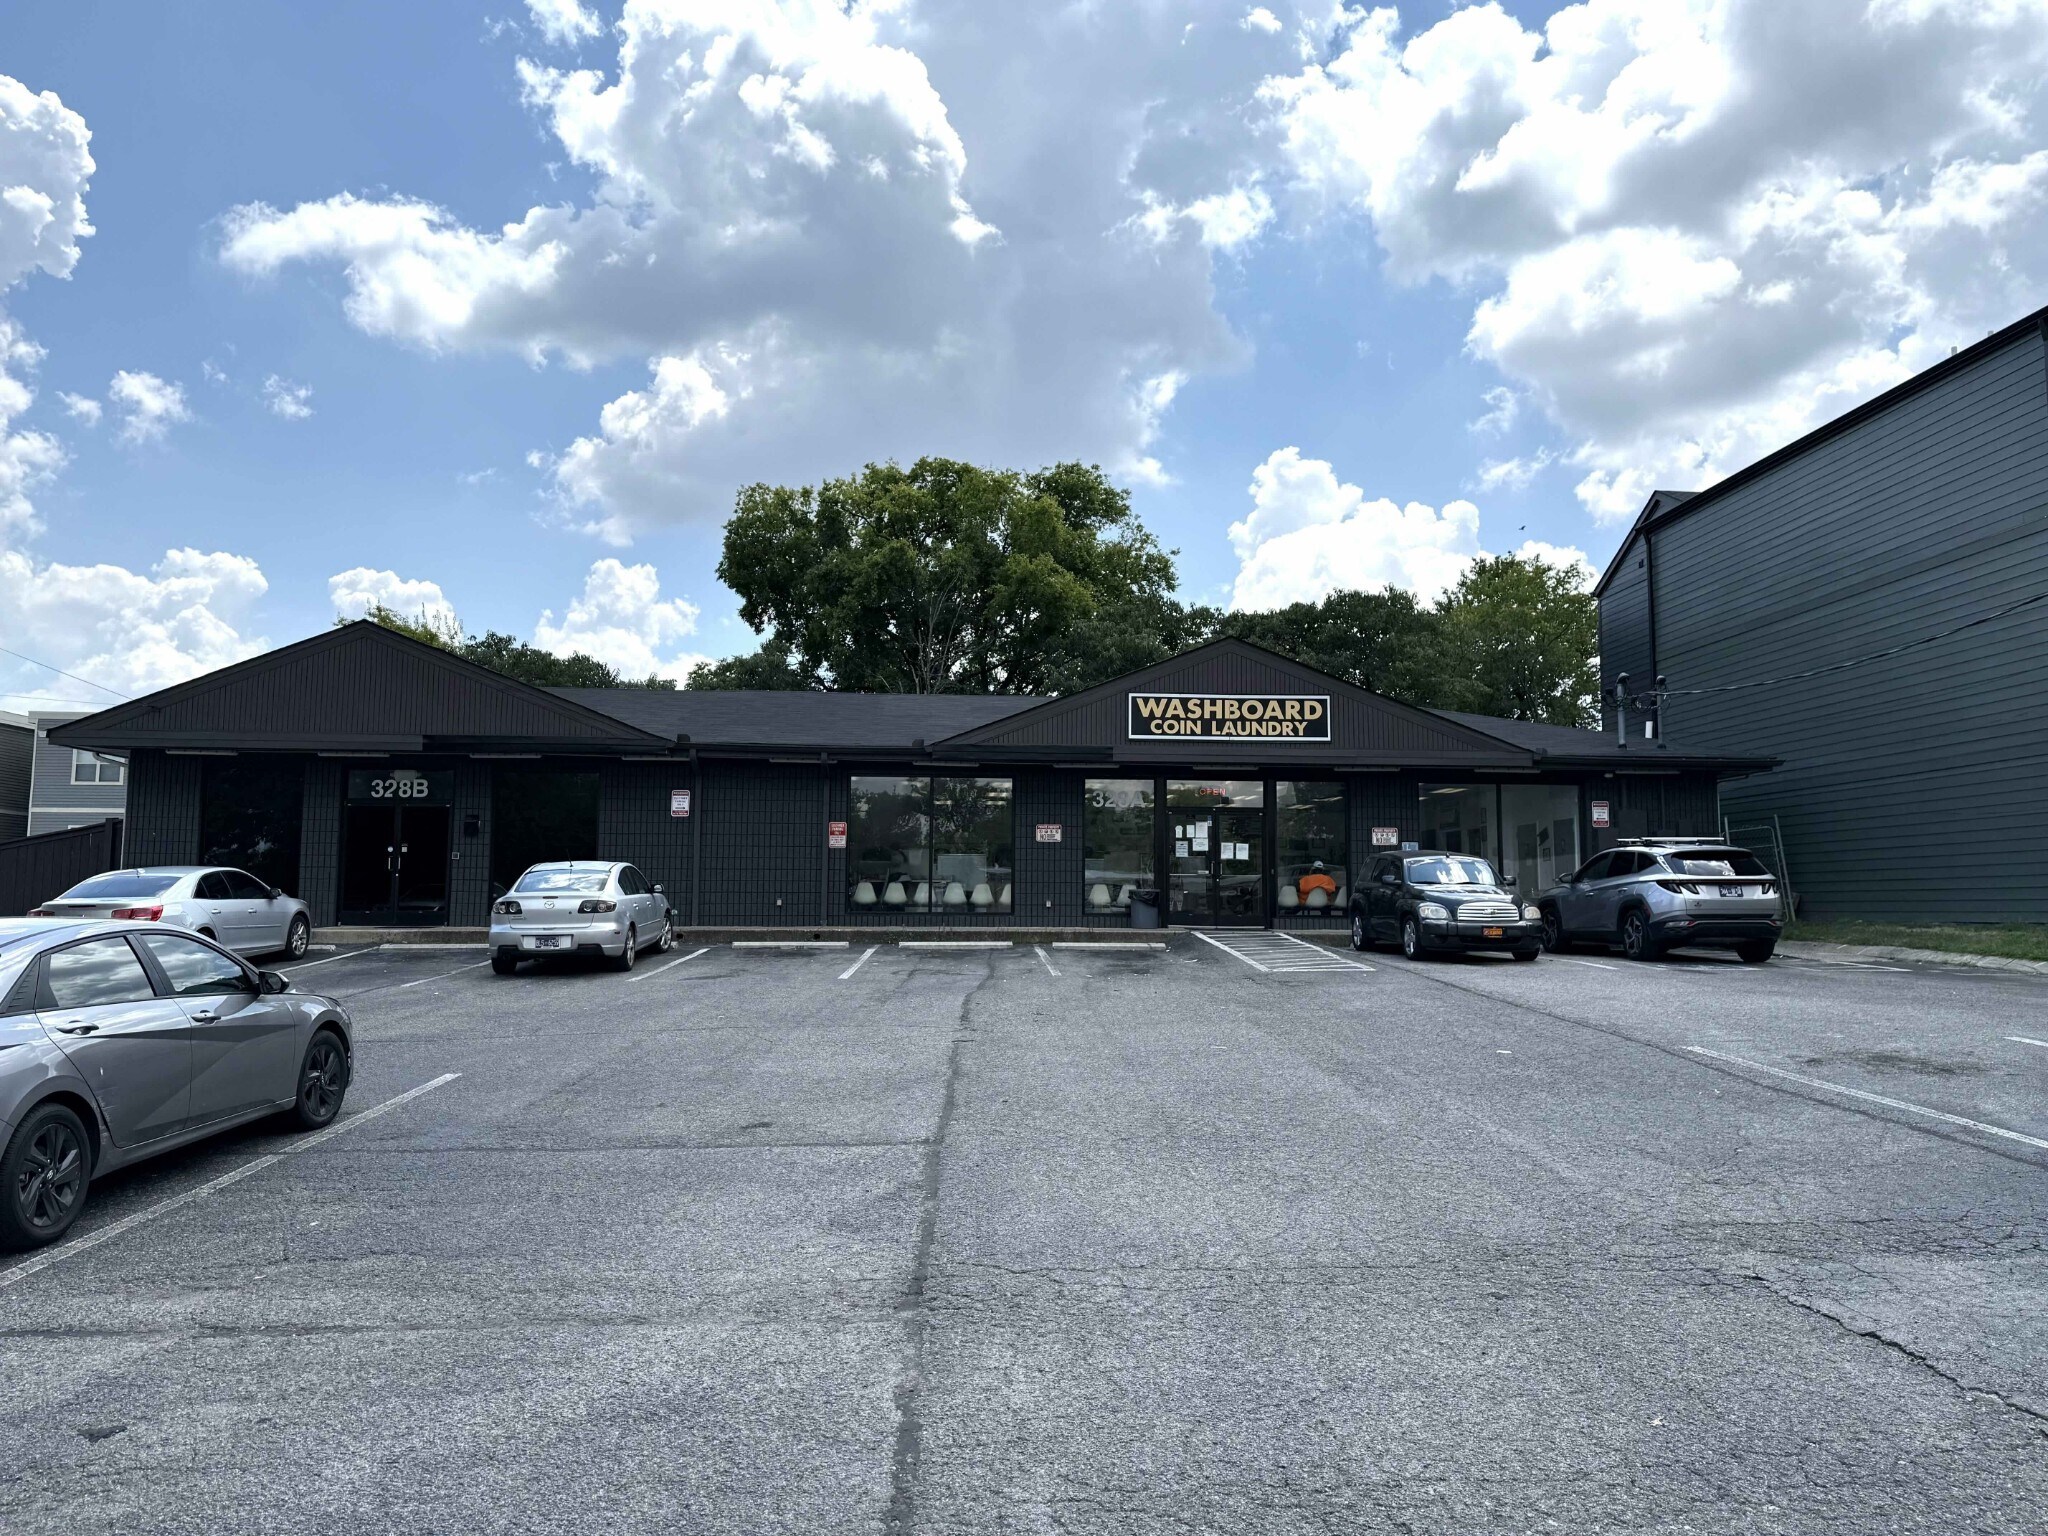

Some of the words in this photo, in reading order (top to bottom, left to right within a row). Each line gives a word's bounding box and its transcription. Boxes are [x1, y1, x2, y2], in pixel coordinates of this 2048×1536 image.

[1136, 697, 1323, 720] WASHBOARD
[1150, 719, 1201, 735] COIN
[1211, 721, 1308, 736] LAUNDRY
[371, 779, 429, 798] 328B
[1199, 788, 1226, 796] OPEN
[1092, 790, 1146, 808] 328A
